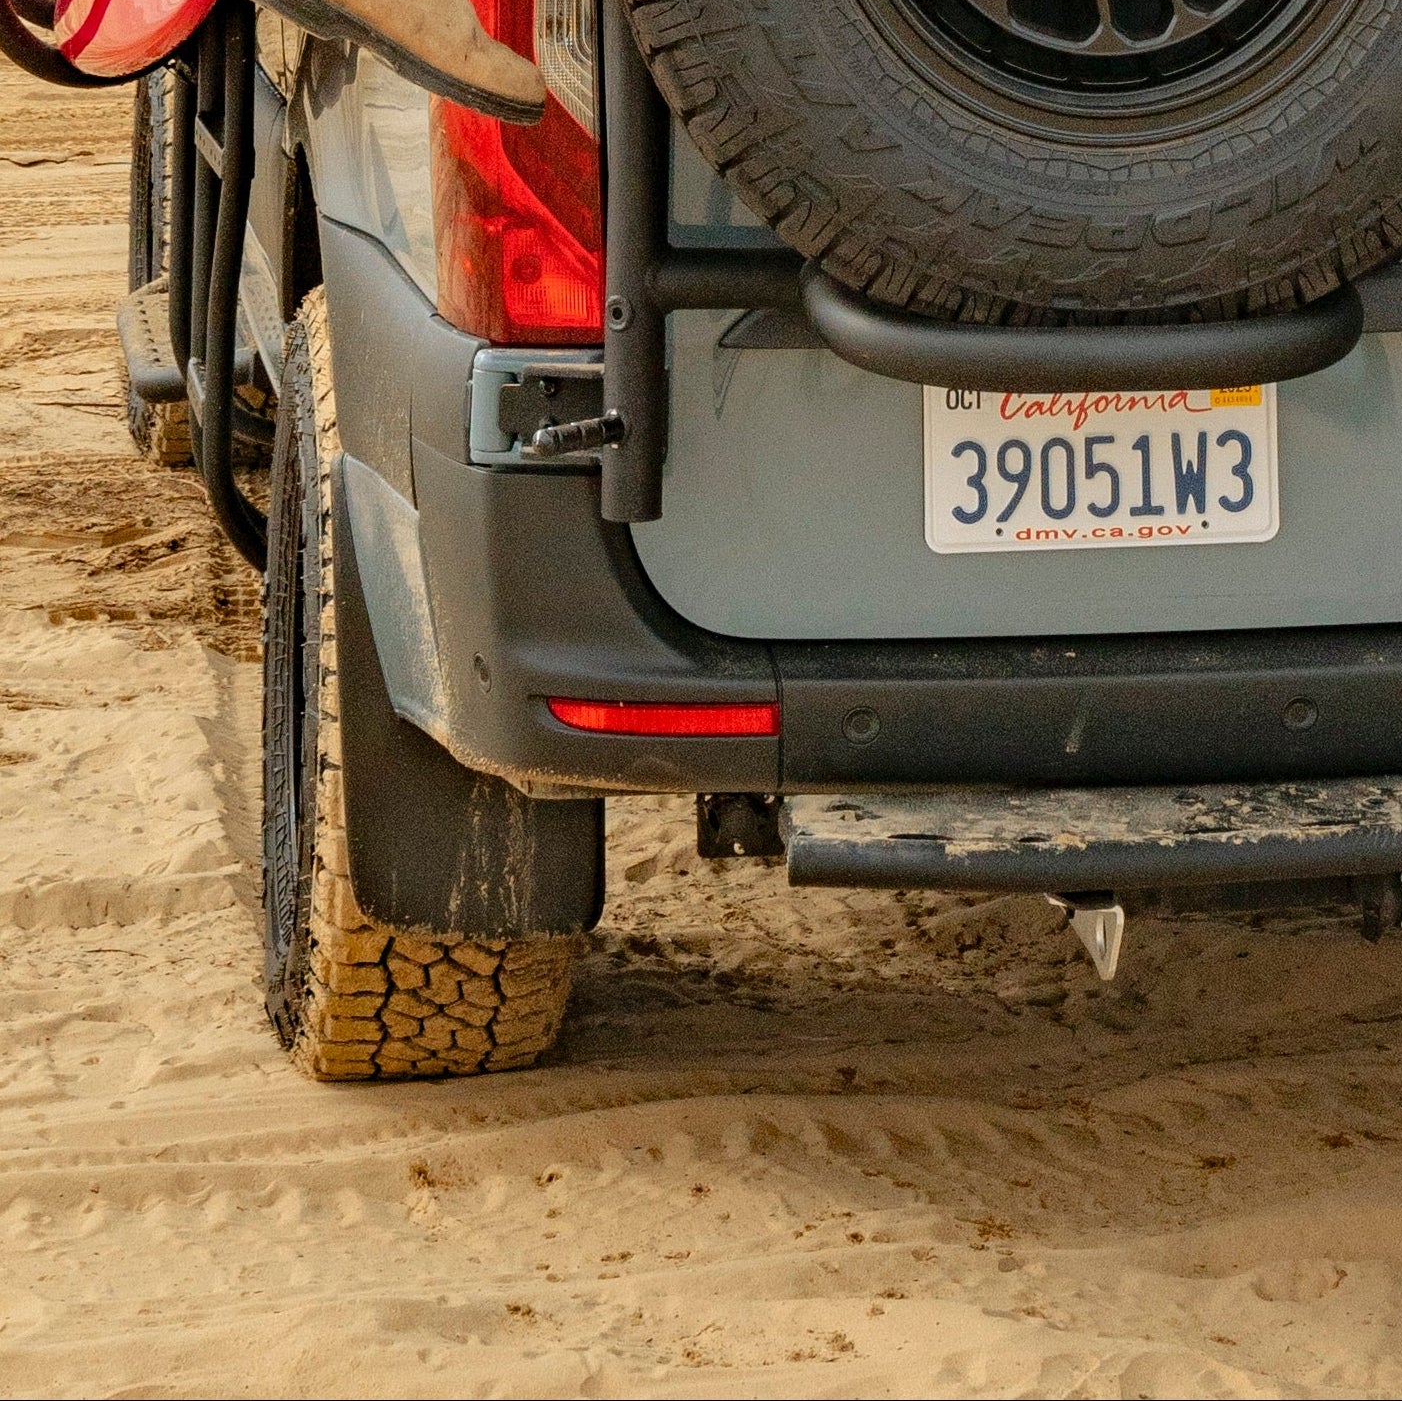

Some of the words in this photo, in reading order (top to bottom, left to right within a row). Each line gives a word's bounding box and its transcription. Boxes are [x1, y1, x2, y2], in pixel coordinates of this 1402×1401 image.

[945, 388, 981, 410] OCT
[1000, 390, 1212, 431] California
[951, 429, 1254, 525] 39051W3
[1016, 523, 1192, 541] dmv.ca.gov
